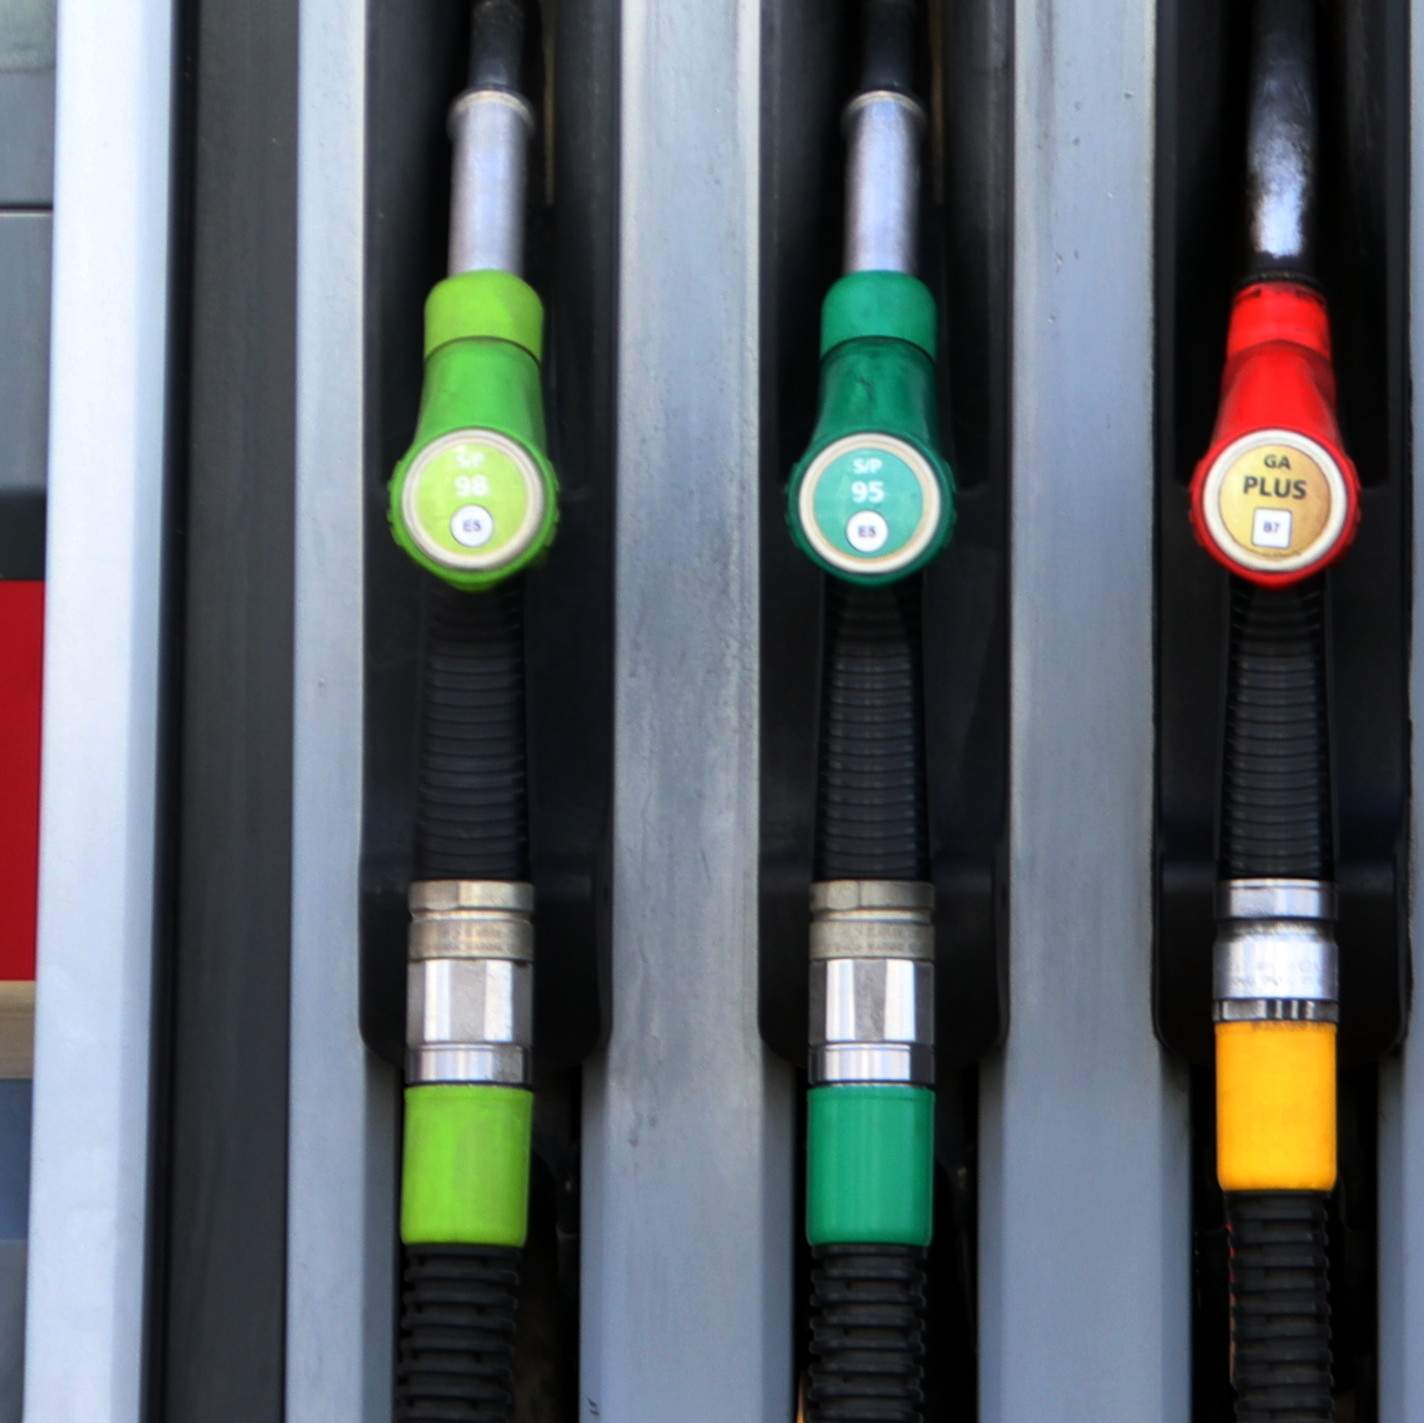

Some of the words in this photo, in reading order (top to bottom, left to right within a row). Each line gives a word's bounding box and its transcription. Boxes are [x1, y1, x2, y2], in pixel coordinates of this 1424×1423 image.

[1263, 454, 1292, 470] GA
[454, 475, 489, 497] 98
[851, 481, 886, 503] 95
[1243, 475, 1308, 500] PLUS
